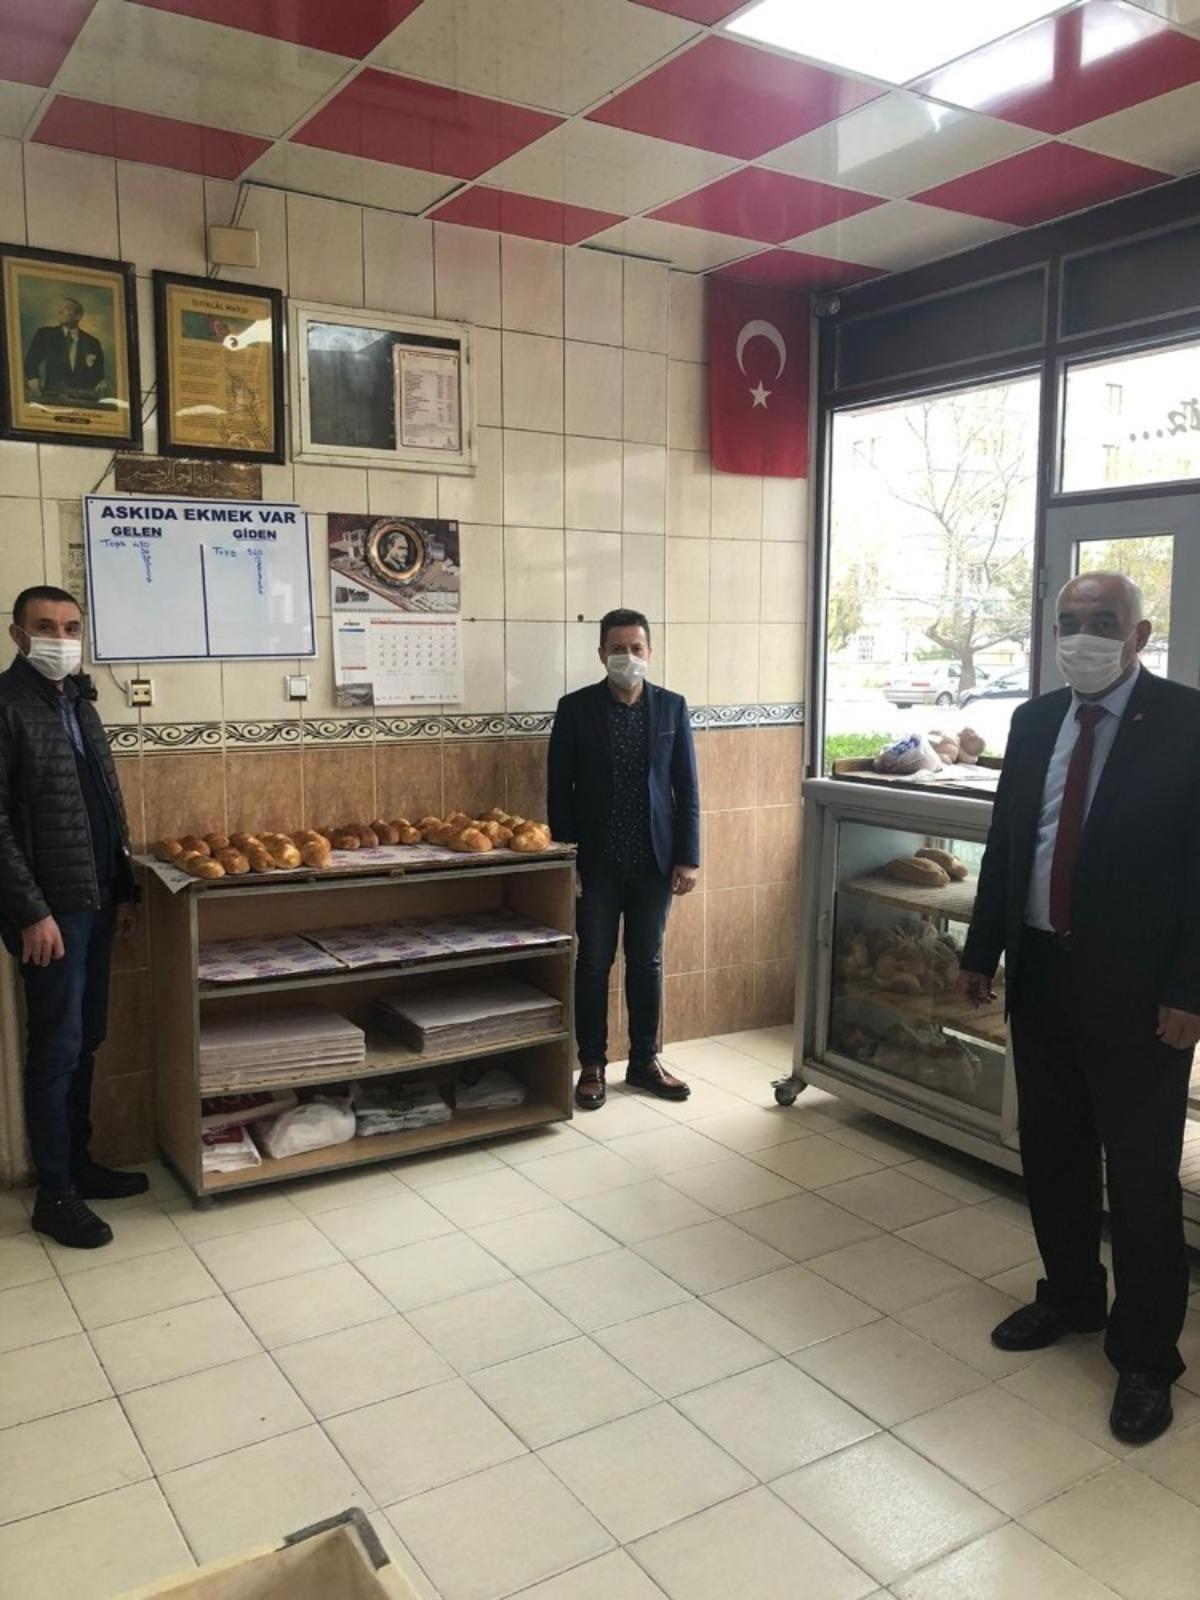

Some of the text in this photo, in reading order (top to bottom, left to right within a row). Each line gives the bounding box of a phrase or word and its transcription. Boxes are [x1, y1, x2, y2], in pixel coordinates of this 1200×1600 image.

[101, 506, 296, 524] ASKIDA EKMEK VAR
[111, 526, 277, 540] GELEN GİDEN
